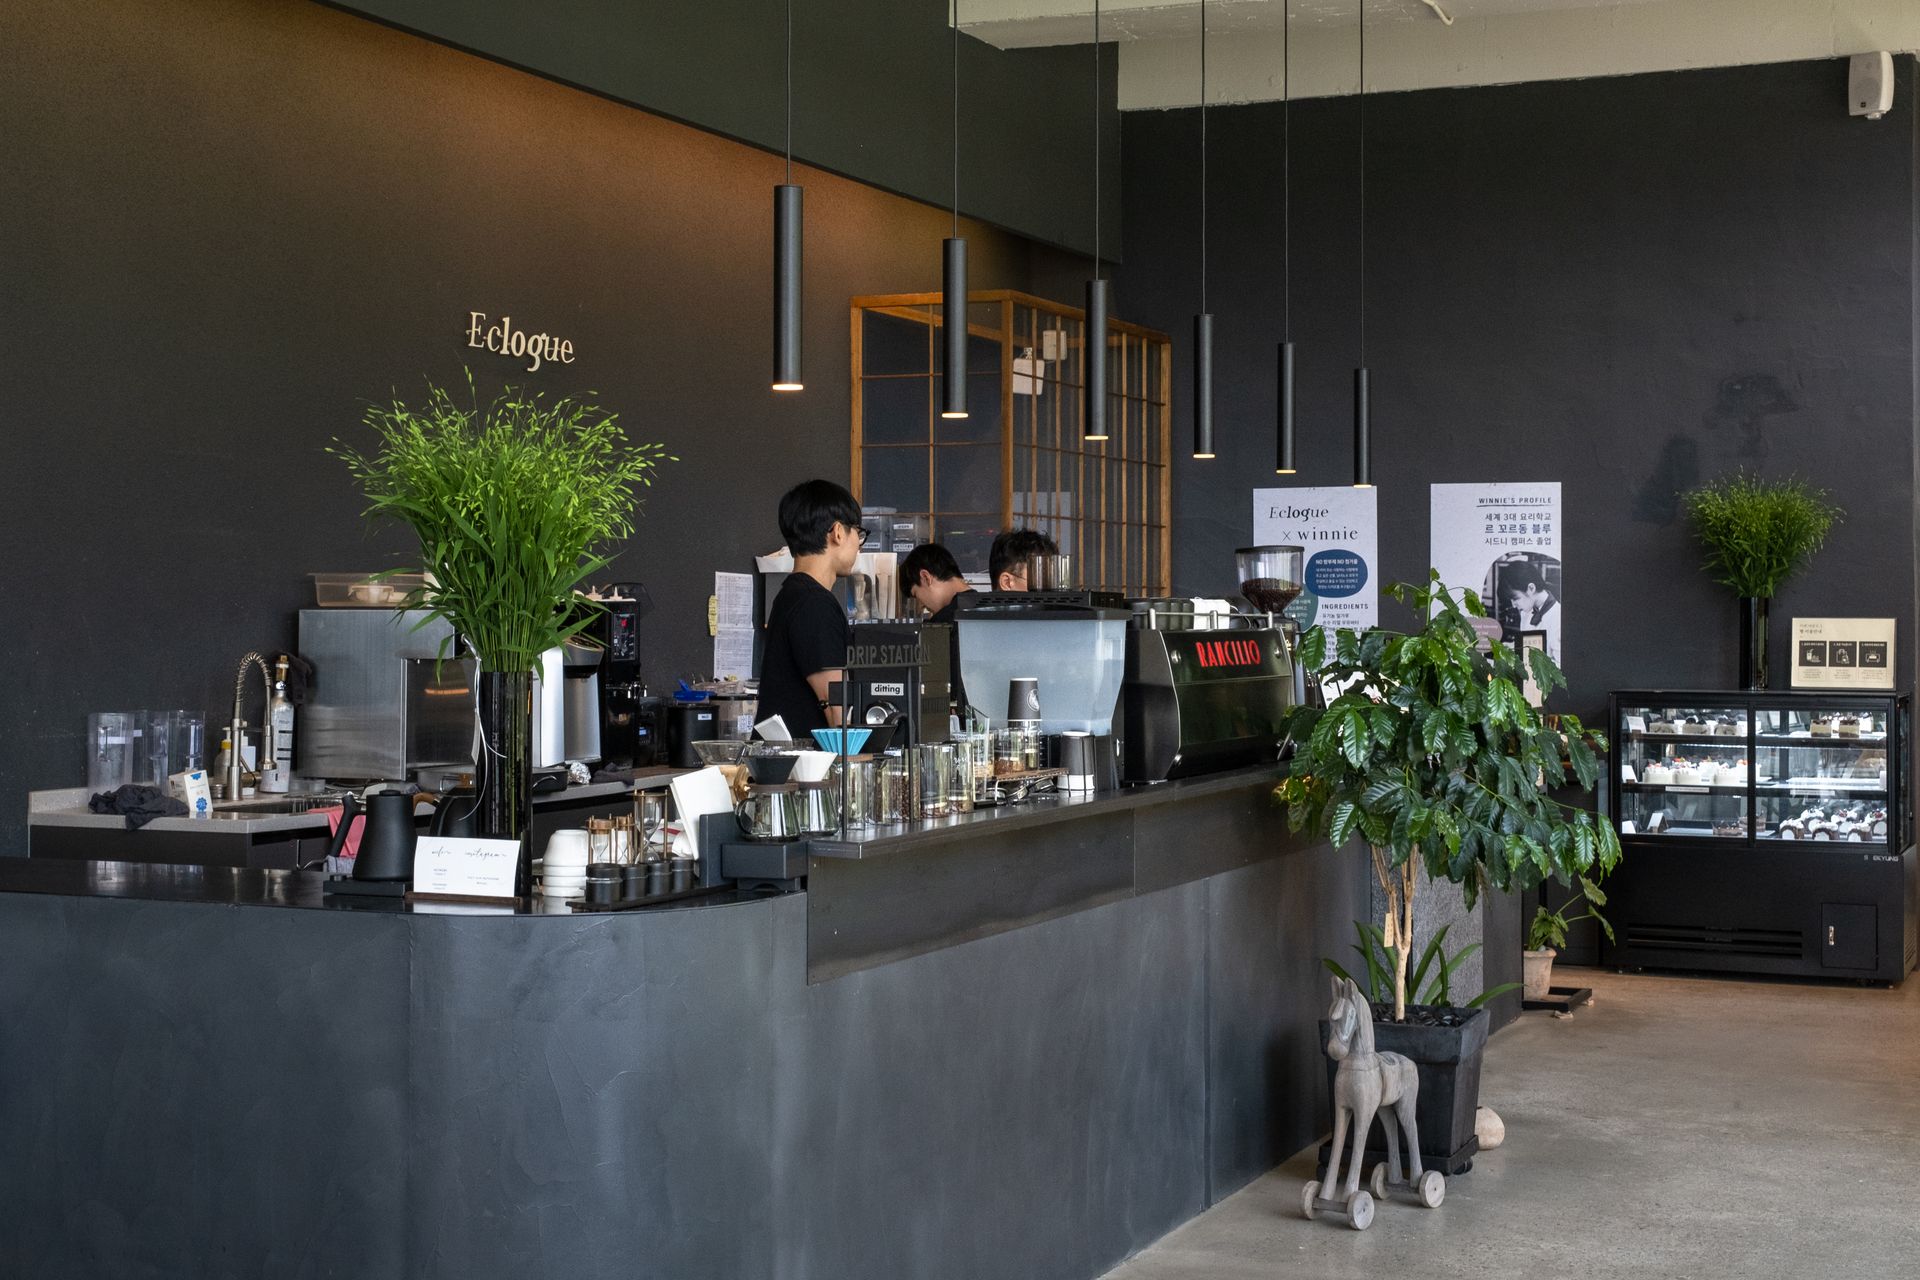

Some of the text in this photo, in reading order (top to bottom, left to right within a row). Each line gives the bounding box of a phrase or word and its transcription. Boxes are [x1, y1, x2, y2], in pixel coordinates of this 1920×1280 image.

[466, 311, 575, 372] Eclogue
[1519, 496, 1552, 504] PROFILE
[1269, 506, 1329, 522] Eclogue
[1485, 512, 1552, 521] 세계 3대 요리학교
[1297, 526, 1359, 541] winnie
[1484, 523, 1552, 535] 르 꼬르동 블루
[1484, 537, 1552, 546] 시드니 캠퍼스 졸업
[846, 644, 931, 666] DRIP STATION
[1195, 639, 1261, 667] RANCILIO
[874, 684, 901, 695] ditting
